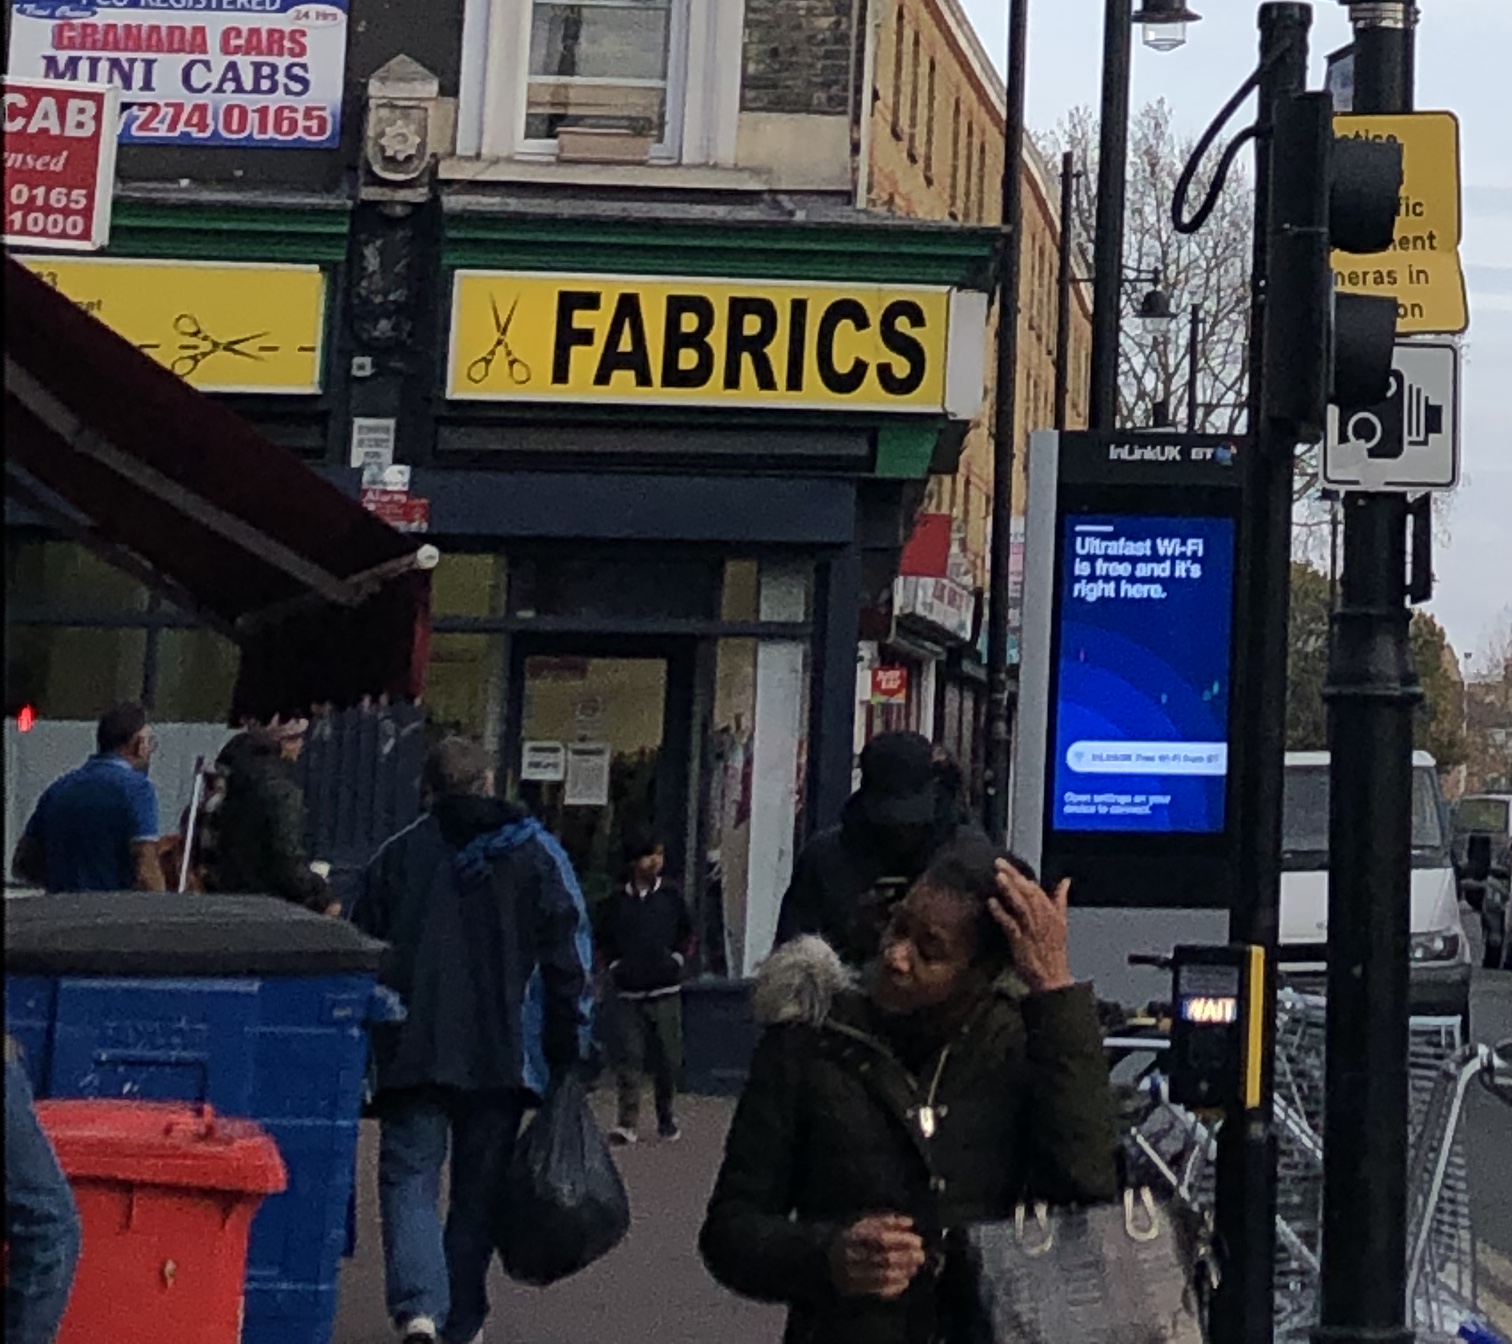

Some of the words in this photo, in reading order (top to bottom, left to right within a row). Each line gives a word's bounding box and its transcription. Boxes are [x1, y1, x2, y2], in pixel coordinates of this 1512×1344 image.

[52, 20, 209, 55] GRANADA
[219, 26, 308, 58] CARS
[41, 55, 158, 93] MINI
[181, 59, 312, 96] CABS
[4, 92, 97, 137] CAB
[118, 100, 212, 137] 274
[219, 102, 331, 140] 0165
[11, 183, 88, 210] 0165
[9, 210, 85, 236] 1000
[1408, 265, 1429, 285] in
[551, 289, 927, 396] FABRICS
[1075, 536, 1152, 556] Ultrafast
[1156, 538, 1204, 557] Wi-Fi
[1074, 558, 1091, 576] is
[1095, 558, 1132, 576] free
[1135, 559, 1171, 578] and
[1174, 560, 1202, 579] it's
[1073, 579, 1116, 602] right
[1119, 580, 1168, 599] here.
[1183, 997, 1237, 1023] WAIT
